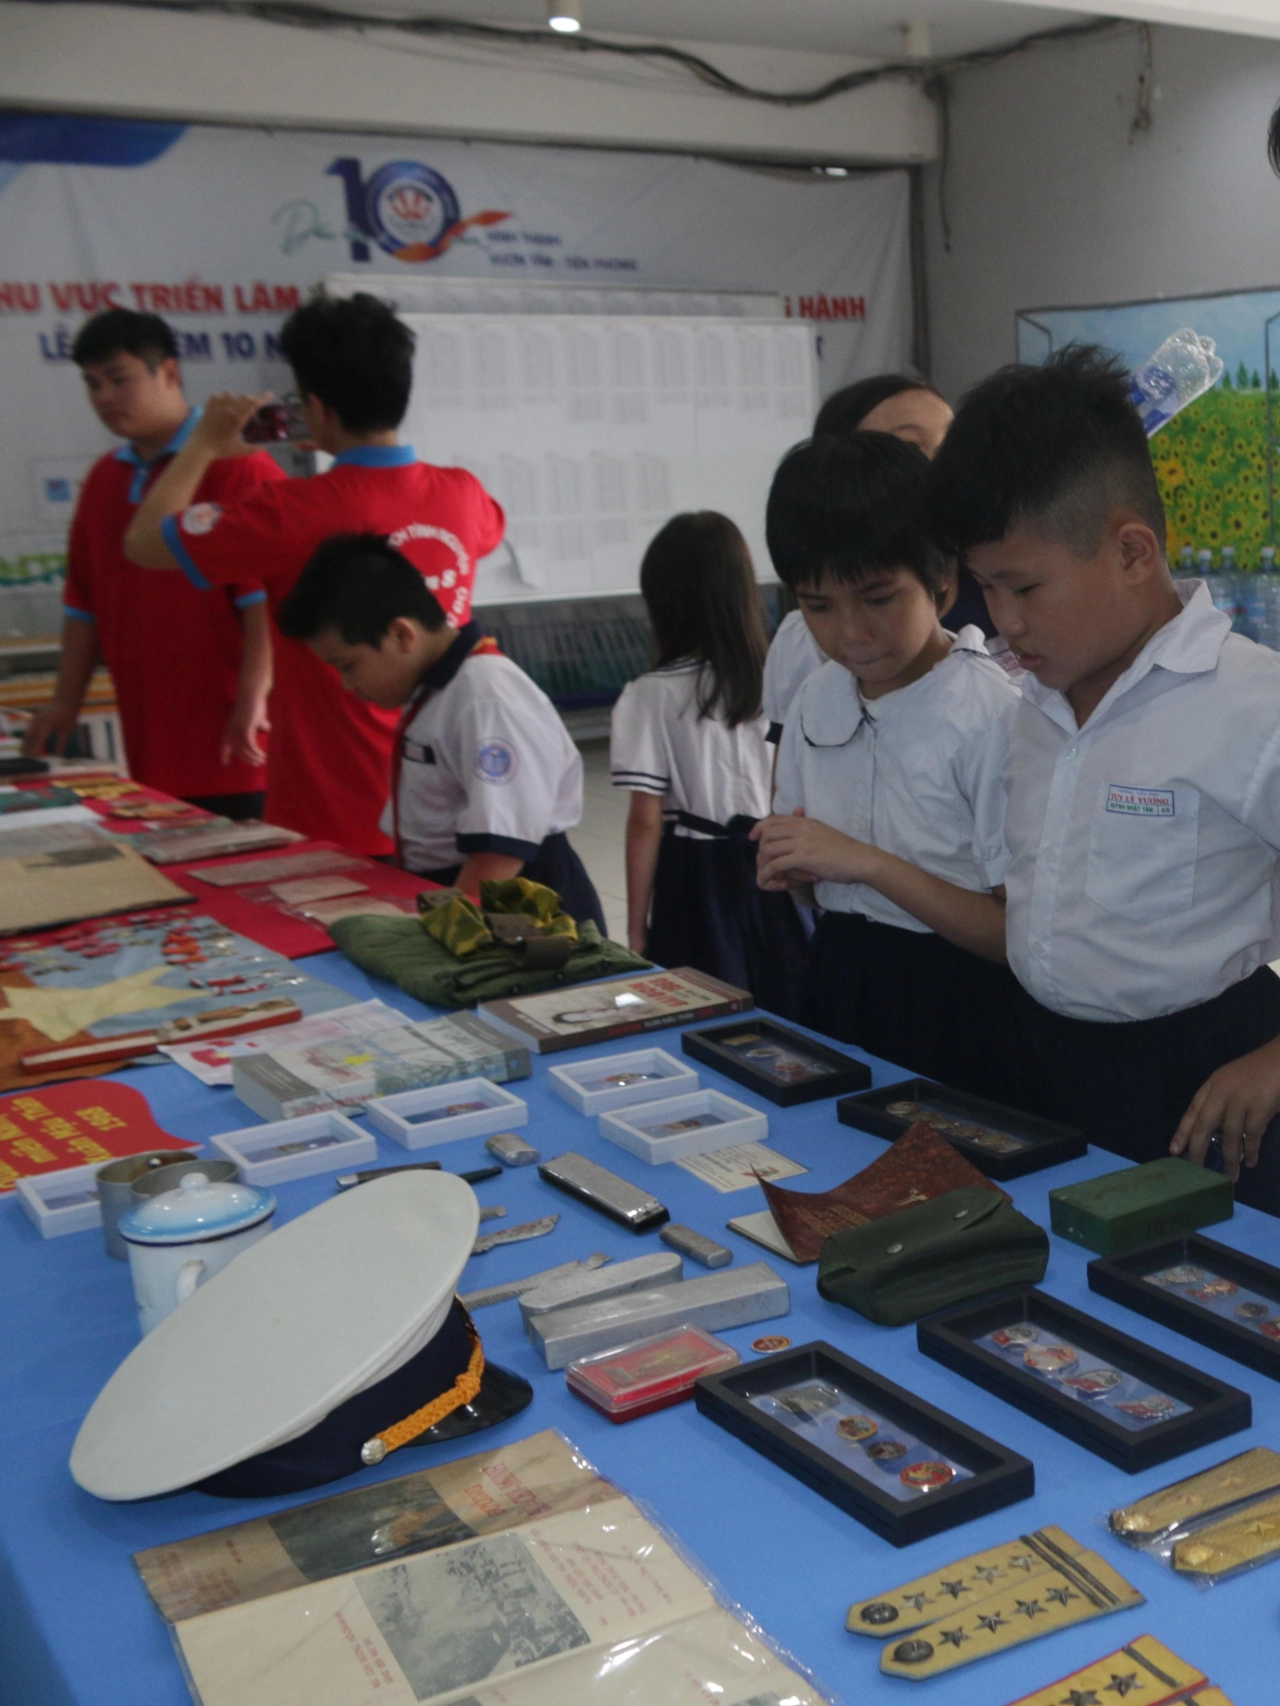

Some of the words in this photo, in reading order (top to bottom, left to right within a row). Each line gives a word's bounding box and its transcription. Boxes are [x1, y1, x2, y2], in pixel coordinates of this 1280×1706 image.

[0, 282, 41, 313] HU
[50, 282, 122, 317] VỰC
[131, 274, 224, 314] TRIỂN
[236, 280, 300, 313] LÃM
[799, 290, 867, 319] HÀNH
[222, 331, 256, 360] 10
